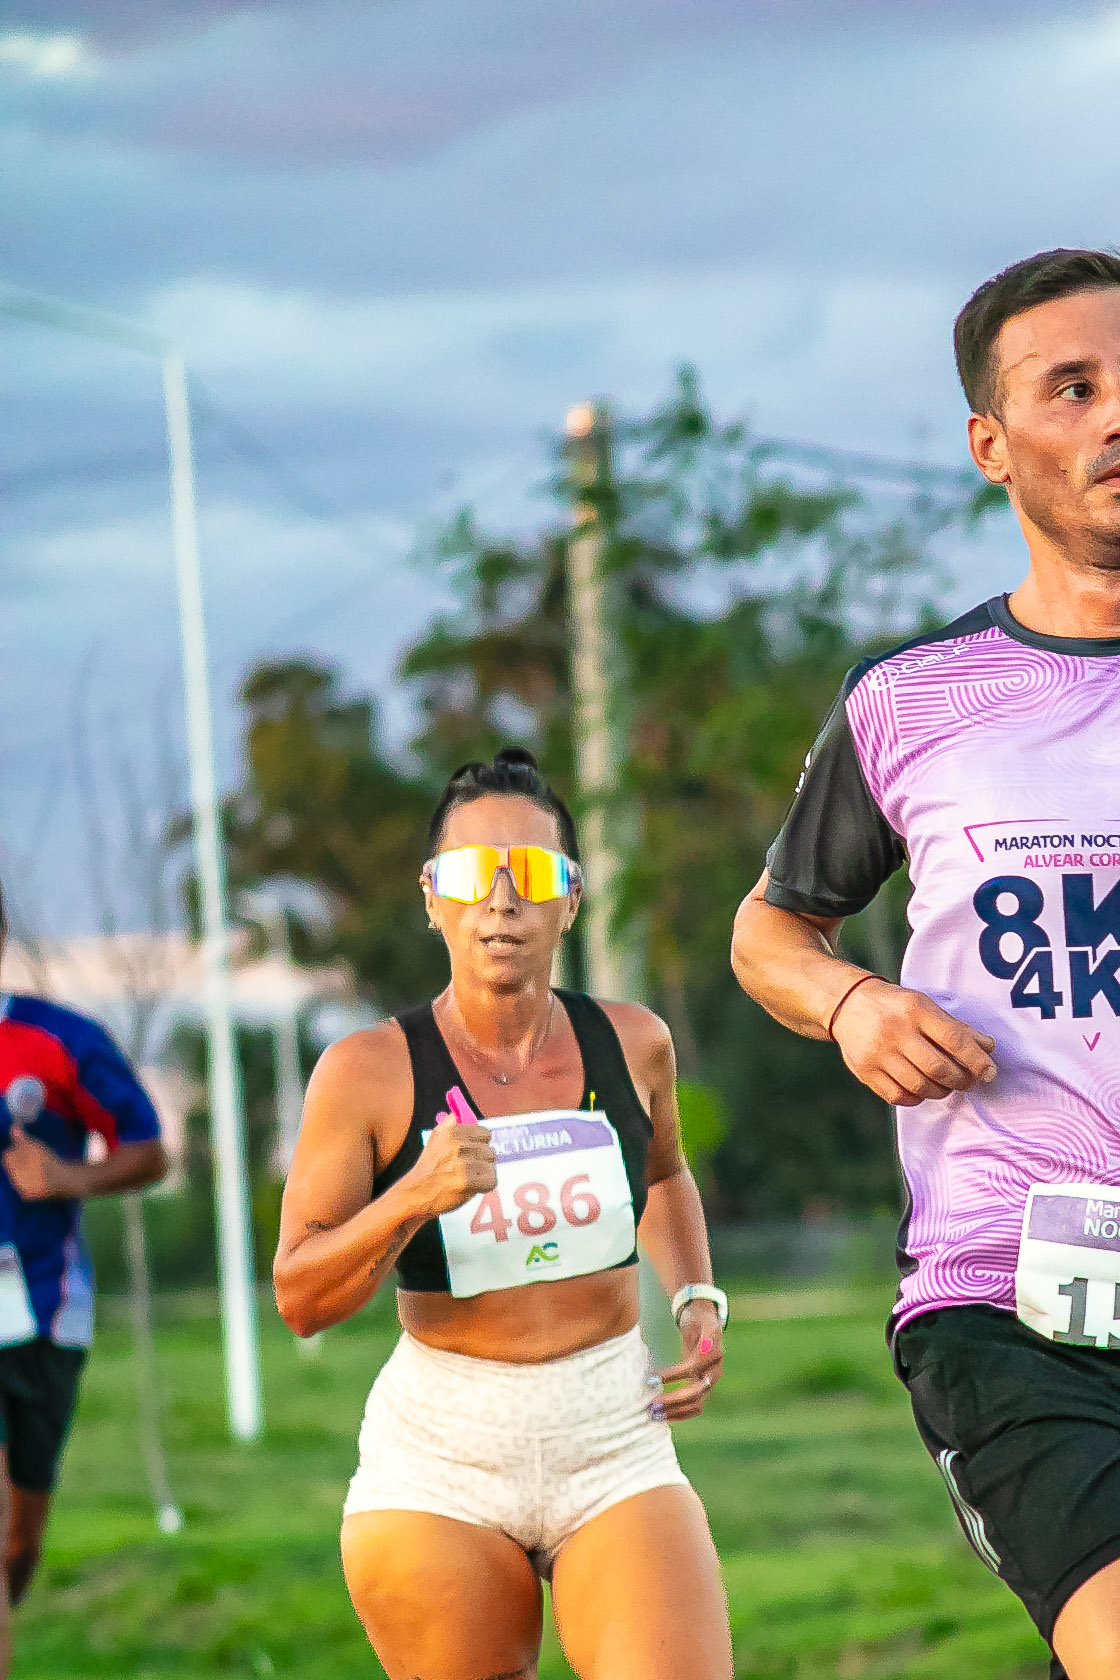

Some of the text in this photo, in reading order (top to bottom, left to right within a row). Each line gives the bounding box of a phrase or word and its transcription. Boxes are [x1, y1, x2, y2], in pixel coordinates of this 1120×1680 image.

[994, 834, 1075, 851] MARATON
[1023, 853, 1085, 868] ALVEAR
[469, 1173, 602, 1243] 486
